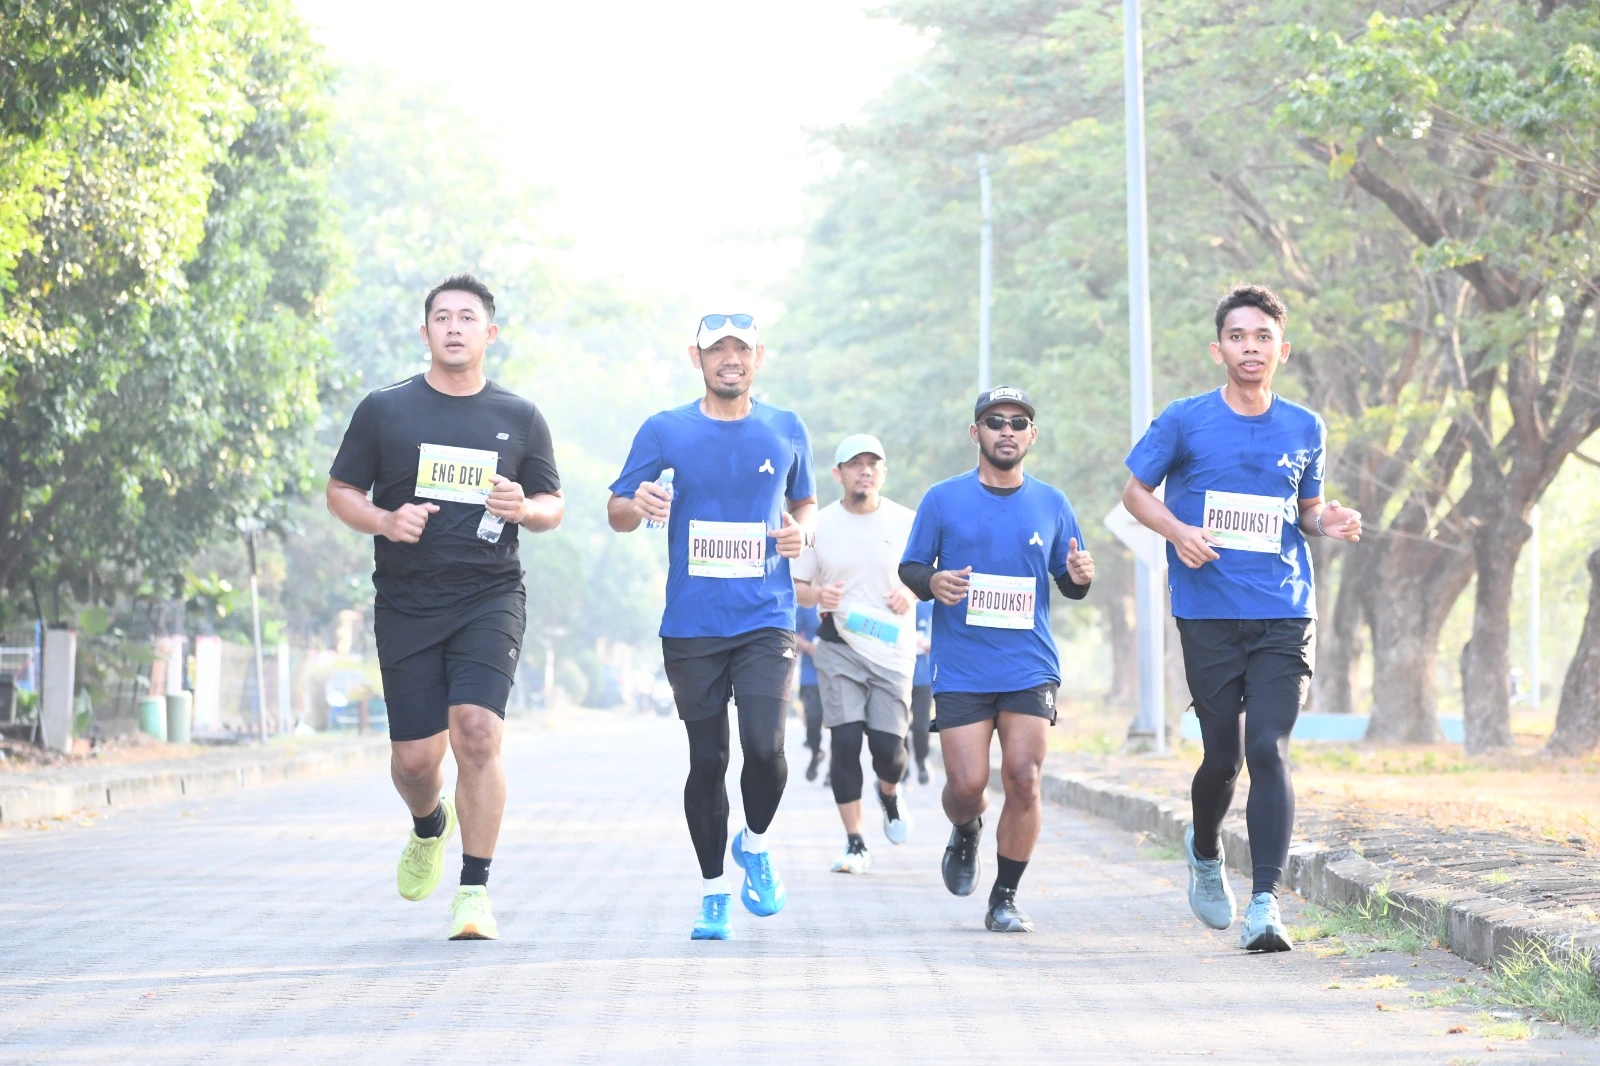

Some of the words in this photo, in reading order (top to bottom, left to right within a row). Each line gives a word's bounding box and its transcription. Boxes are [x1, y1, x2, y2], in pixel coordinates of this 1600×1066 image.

[431, 462, 455, 483] ENG
[459, 465, 483, 487] DEV
[1207, 508, 1269, 534] PRODUKSI
[1273, 514, 1278, 534] 1
[693, 538, 752, 560] PRODUKSI
[756, 540, 761, 560] 1
[971, 589, 1026, 612] PRODUKSI
[1028, 594, 1033, 612] 1
